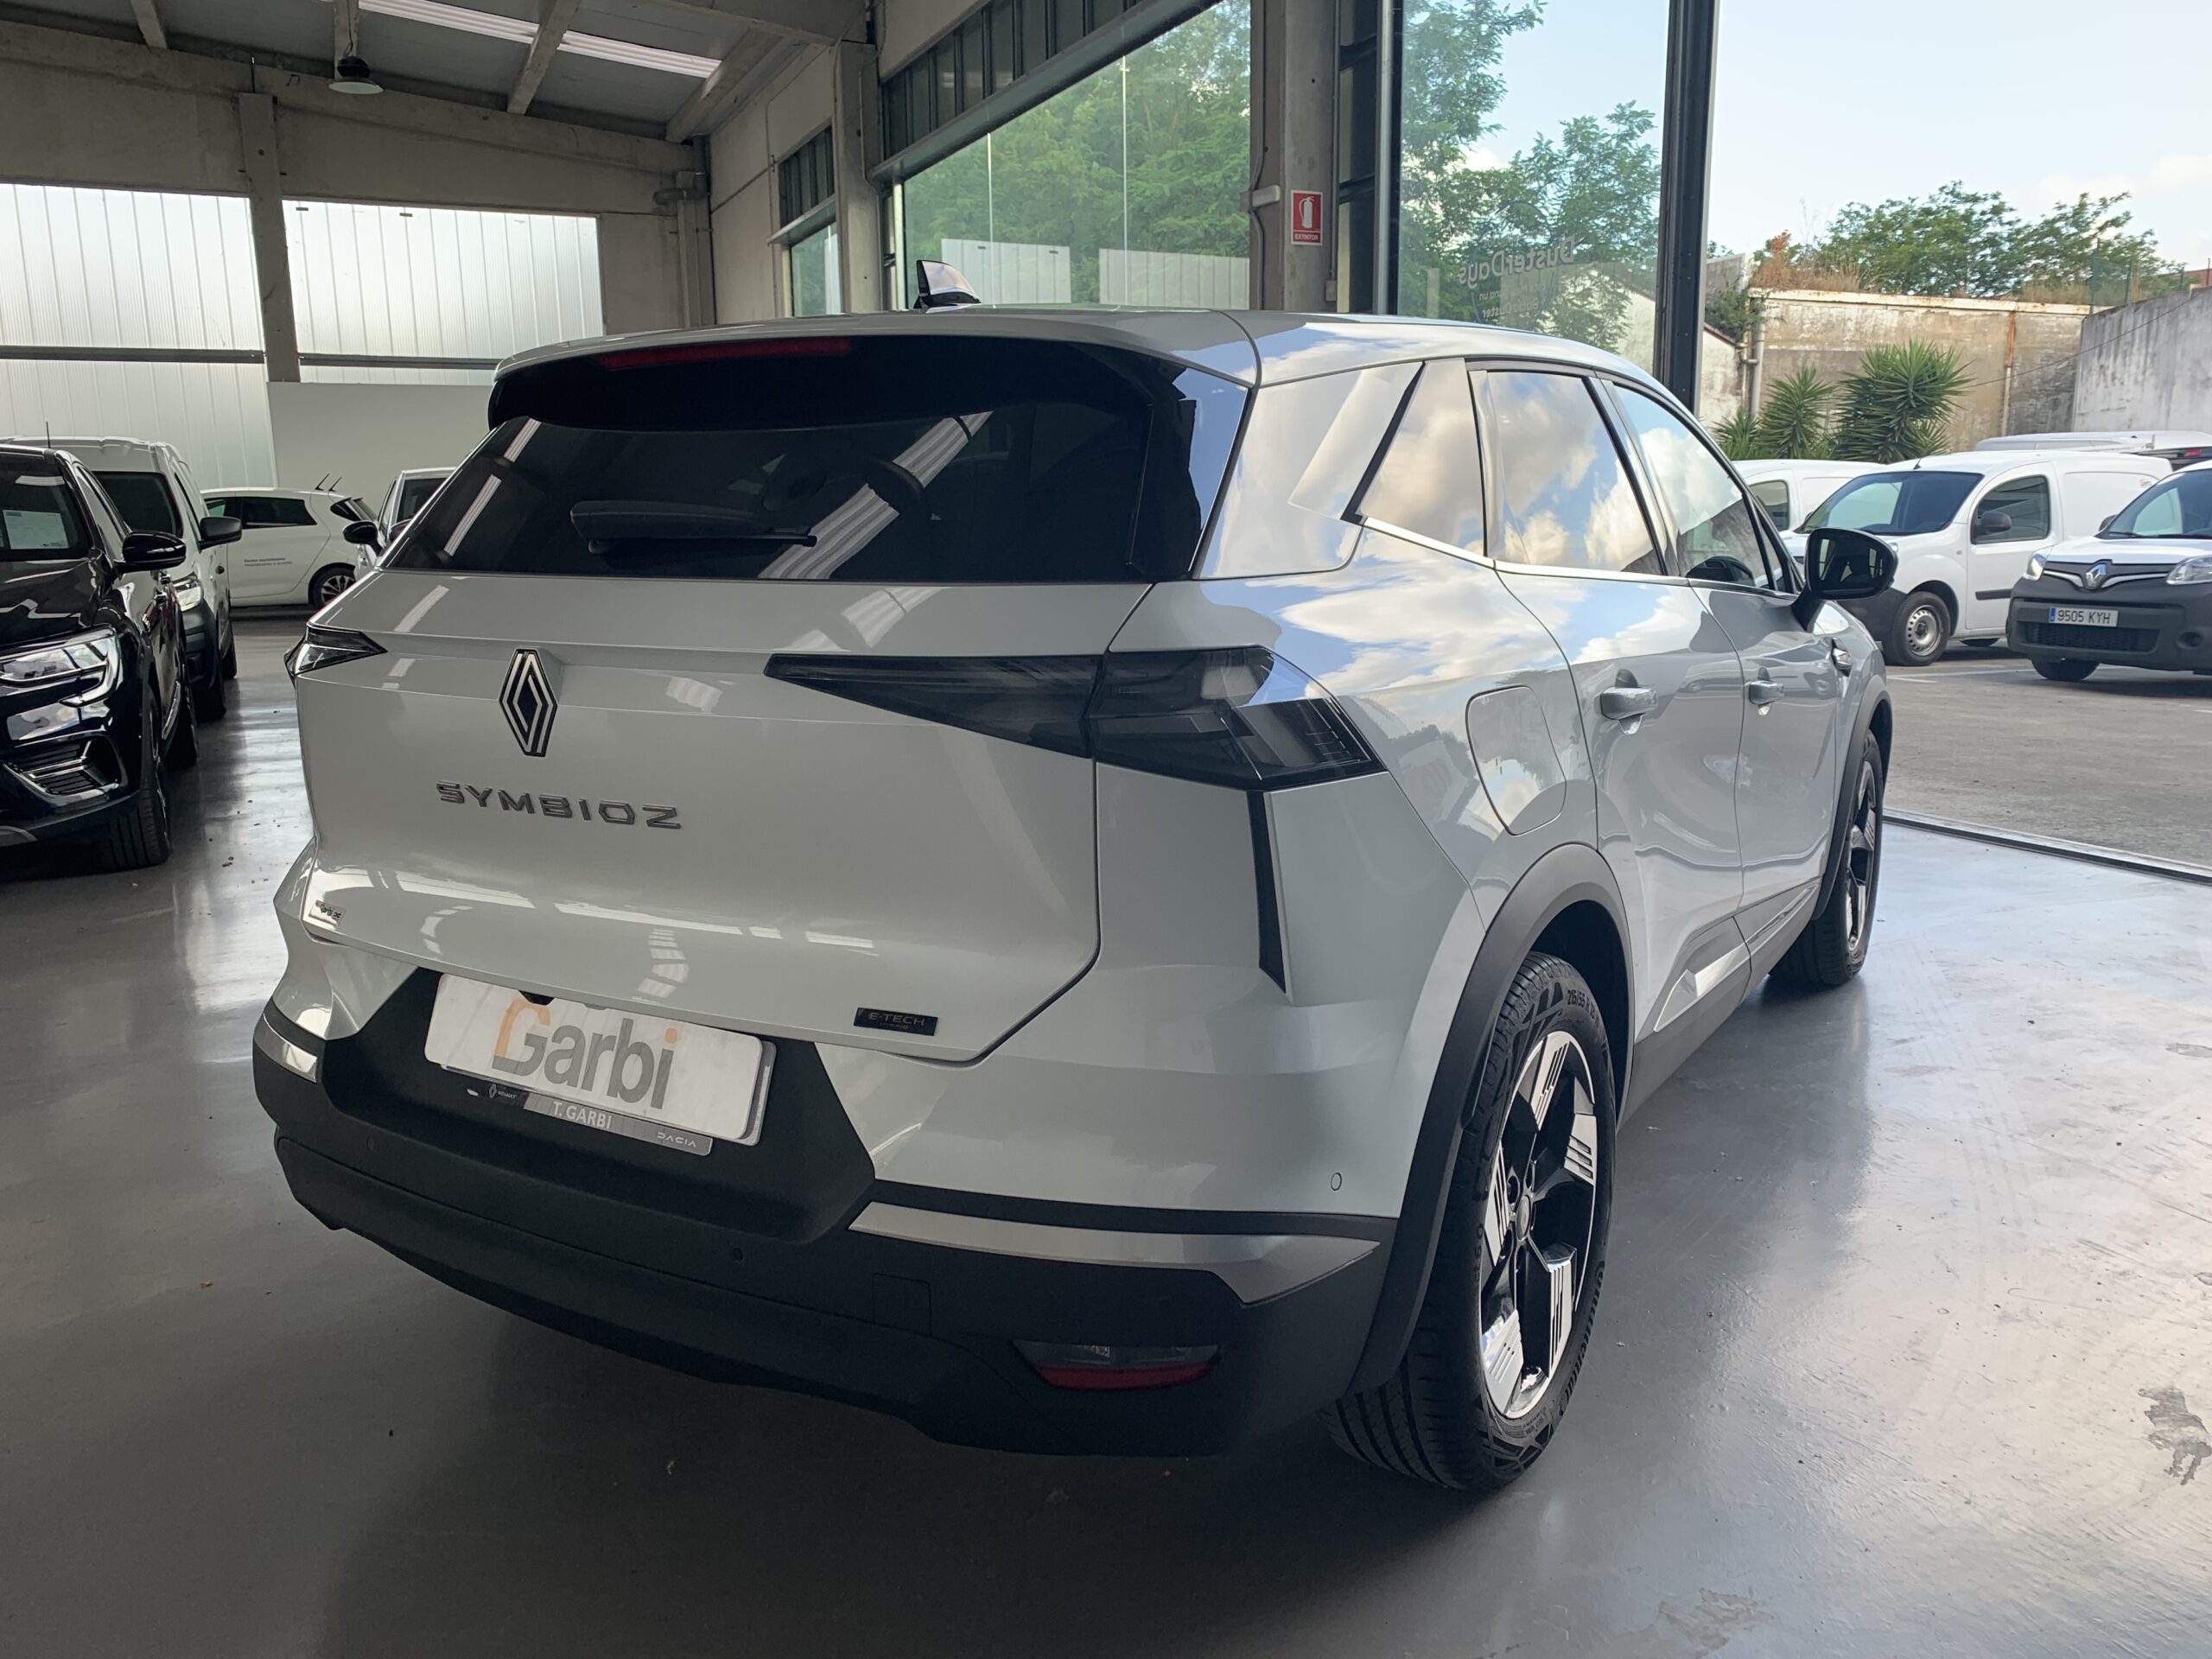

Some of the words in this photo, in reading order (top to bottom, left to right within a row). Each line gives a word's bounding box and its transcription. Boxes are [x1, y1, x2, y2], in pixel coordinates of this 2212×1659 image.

[2057, 609, 2084, 622] 9505
[2088, 611, 2111, 625] KYH
[435, 780, 682, 829] SYMBIOZ
[868, 1012, 926, 1027] E-TECH
[491, 997, 679, 1109] Garbi
[552, 1101, 563, 1116] T.
[566, 1105, 614, 1130] GARBI
[657, 1131, 697, 1148] DACIA
